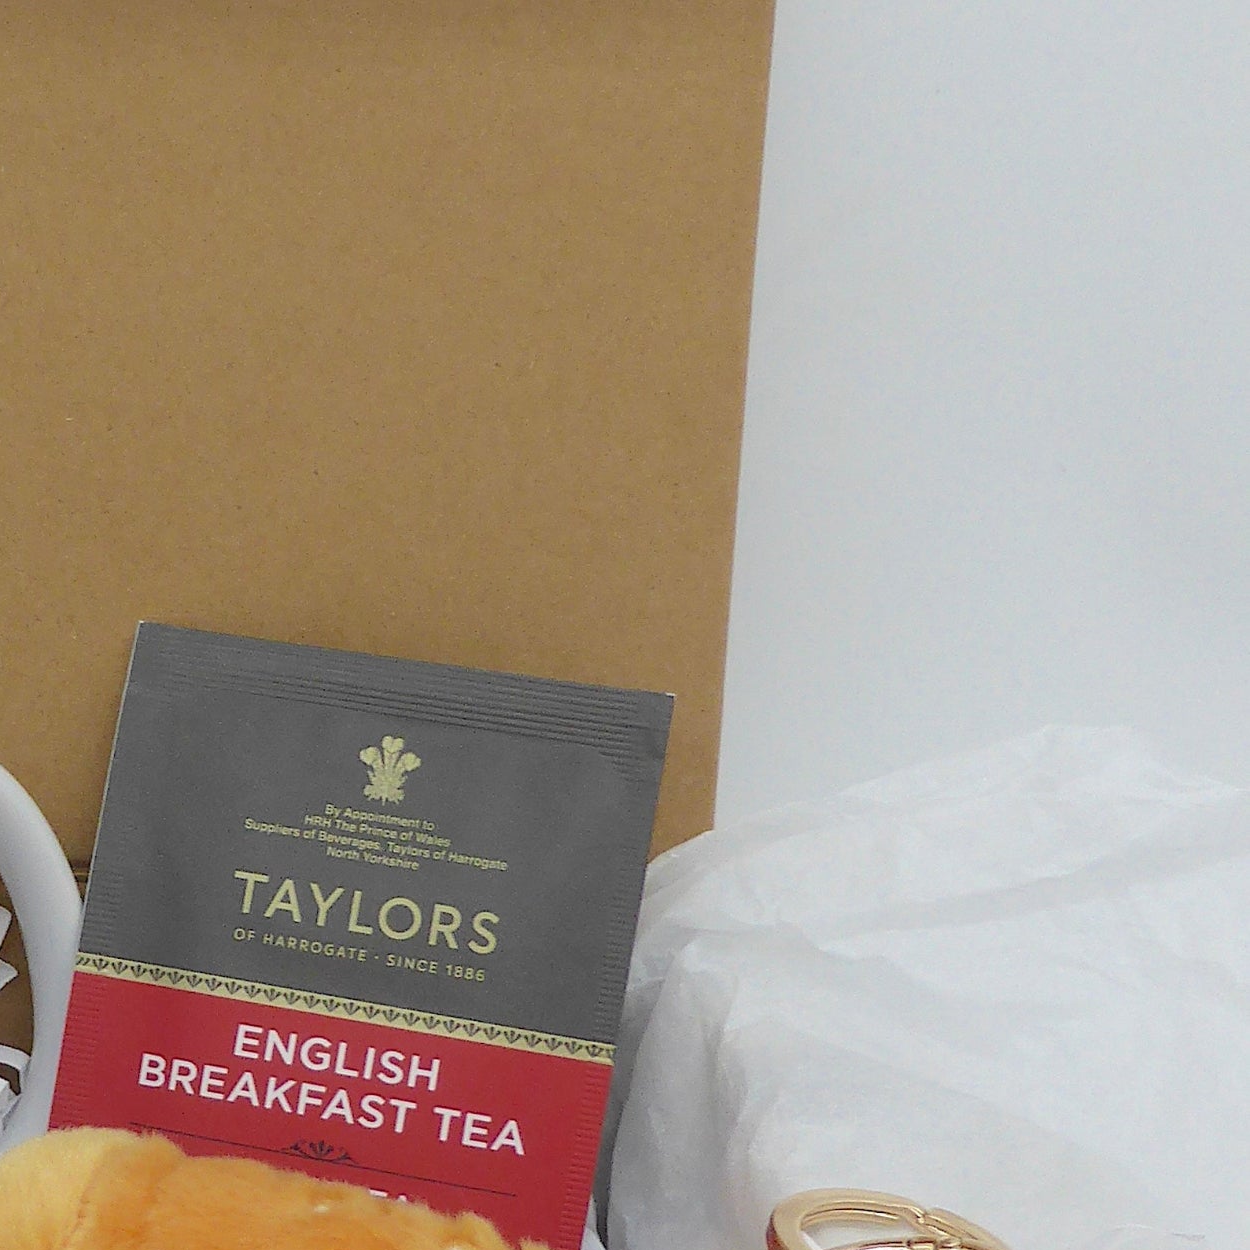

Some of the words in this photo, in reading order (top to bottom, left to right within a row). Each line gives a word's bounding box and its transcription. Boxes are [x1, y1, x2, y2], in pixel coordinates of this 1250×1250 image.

[245, 818, 301, 837] Suppliers
[303, 829, 316, 839] of
[387, 841, 430, 858] Taylors
[432, 850, 447, 860] of
[448, 852, 509, 871] Harrogate
[305, 815, 332, 828] HRH
[335, 820, 357, 833] The
[359, 823, 398, 839] Prince
[399, 831, 413, 841] of
[415, 833, 450, 847] Wales
[325, 804, 341, 818] By
[344, 808, 420, 828] Appointment
[422, 820, 435, 831] to
[327, 847, 359, 859] North
[362, 852, 420, 871] Yorkshire
[234, 870, 500, 954] TAYLORS
[233, 927, 256, 941] OF
[262, 932, 368, 962] HARROGATE
[386, 953, 438, 974] SINCE
[445, 964, 486, 982] 1886
[233, 1024, 441, 1092] ENGLISH
[138, 1053, 417, 1134] BREAKFAST
[433, 1106, 525, 1156] TEA
